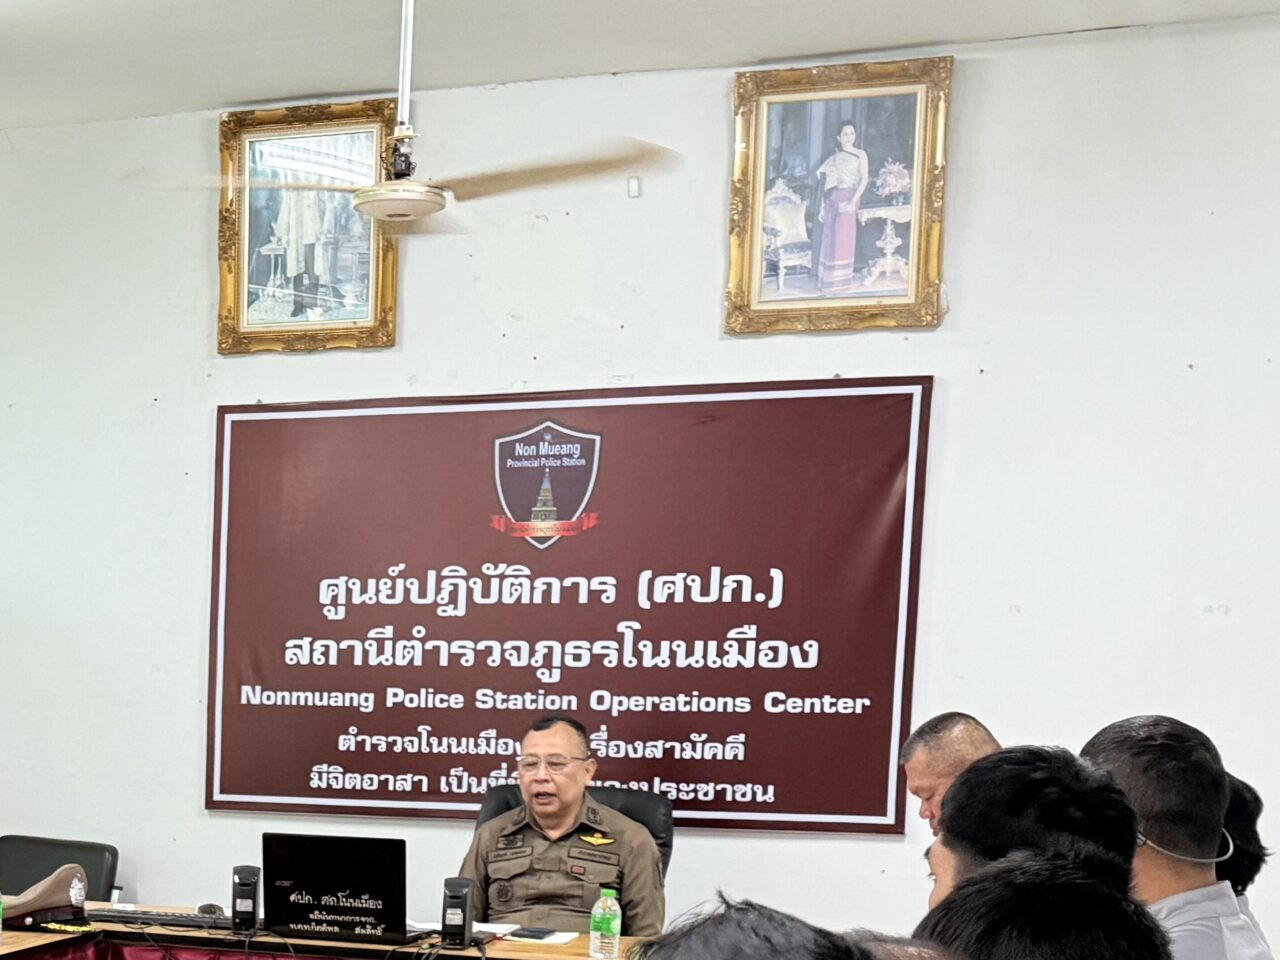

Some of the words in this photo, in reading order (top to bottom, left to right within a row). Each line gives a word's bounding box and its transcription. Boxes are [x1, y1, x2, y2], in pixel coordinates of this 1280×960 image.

[506, 458, 539, 468] Provincial
[540, 457, 561, 467] Police
[561, 456, 586, 467] Station
[514, 442, 536, 456] Non
[539, 441, 581, 458] Mueang
[318, 562, 618, 620] ศูนย์ปฏิบัติการ
[637, 565, 784, 610] (ศปก.)
[284, 622, 819, 684] สถานีตำรวจภูธรโนนเมือง
[240, 685, 375, 713] Nonmuang
[385, 687, 465, 709] Police
[474, 688, 578, 711] Station
[589, 689, 752, 717] Operations
[763, 690, 871, 714] Center
[587, 725, 746, 760] รื่องสามัคคี
[309, 763, 429, 792] มีจิตอาสา
